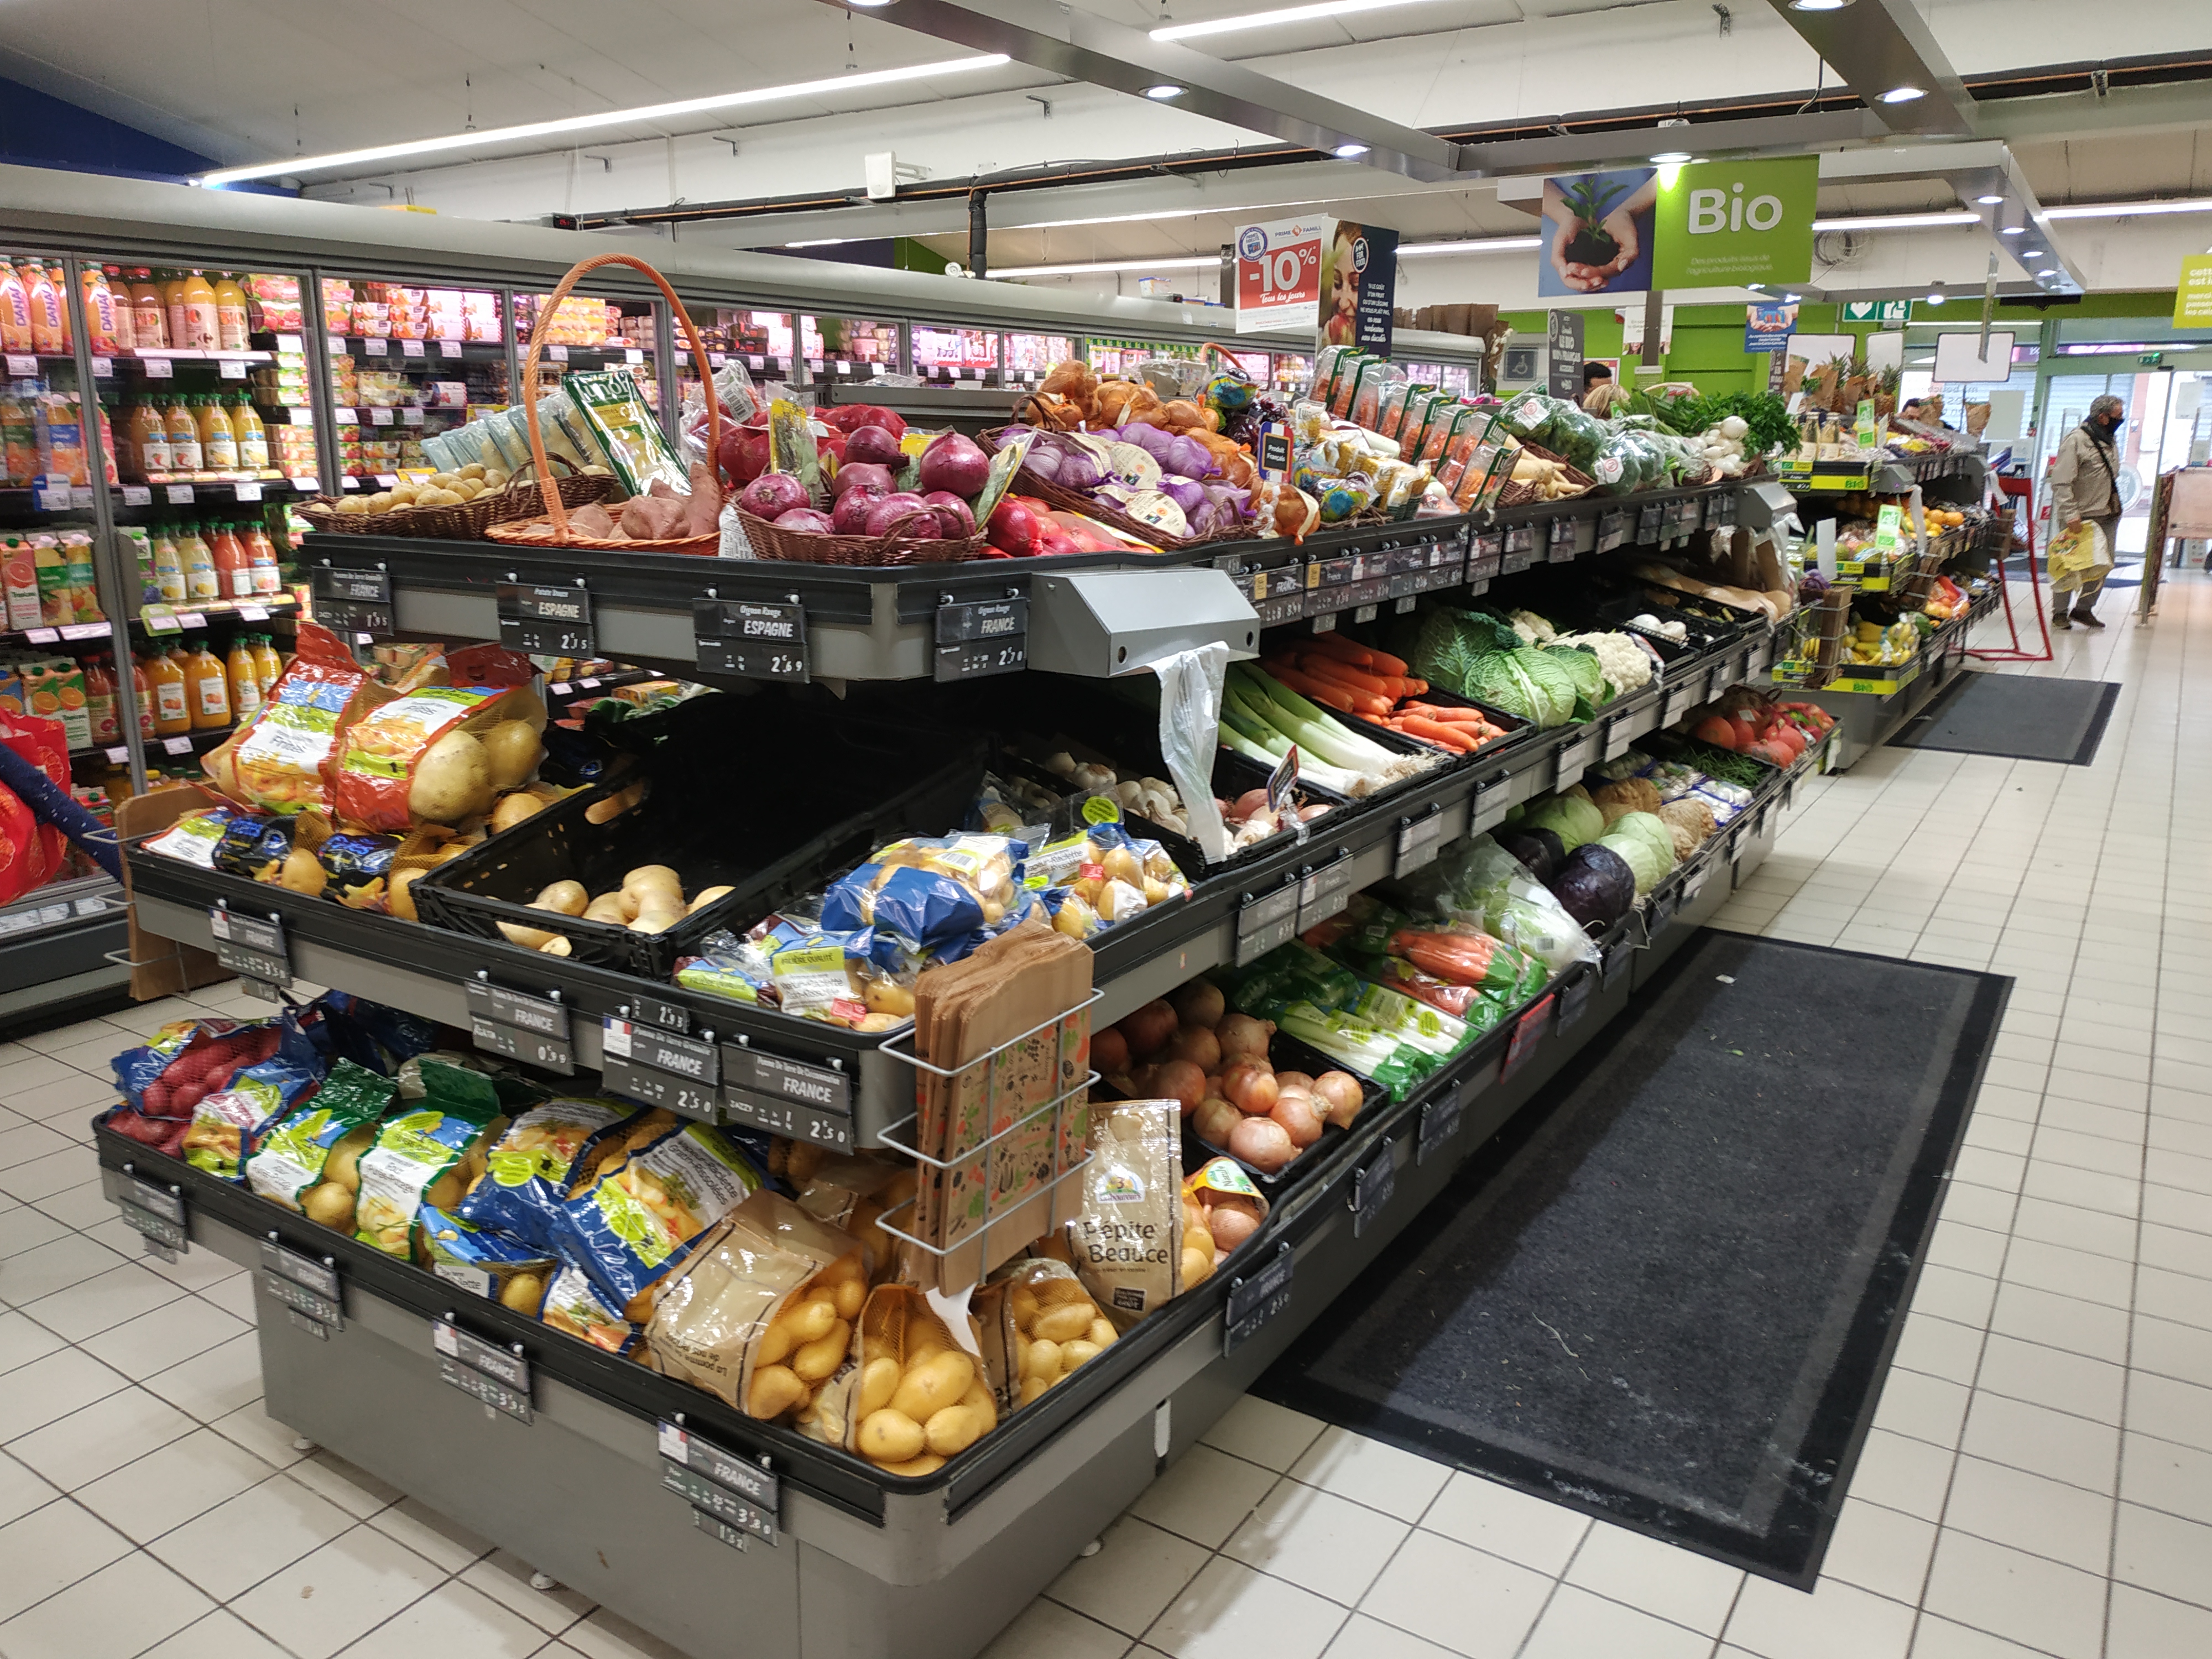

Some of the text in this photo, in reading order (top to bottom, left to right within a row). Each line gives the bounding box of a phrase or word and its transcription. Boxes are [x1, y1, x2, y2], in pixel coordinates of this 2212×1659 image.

[1688, 182, 1783, 234] Bio
[1355, 258, 1366, 267] FOOD
[1356, 251, 1364, 260] FOR
[2189, 268, 2212, 277] cett
[1260, 291, 1306, 304] Tous les jours
[1266, 452, 1286, 462] Français
[1267, 444, 1285, 453] Produit
[350, 583, 379, 597] FRANCE
[538, 601, 580, 618] ESPAGNE
[743, 619, 794, 638] ESPAGNE
[980, 616, 1016, 634] FRANCE
[514, 1008, 554, 1032] FRANCE
[656, 1048, 703, 1076] FRANCE
[782, 1076, 833, 1103] FRANCE
[1087, 1244, 1168, 1264] Beauce
[478, 1354, 517, 1383] FRANCE
[713, 1462, 761, 1496] FRANCE
